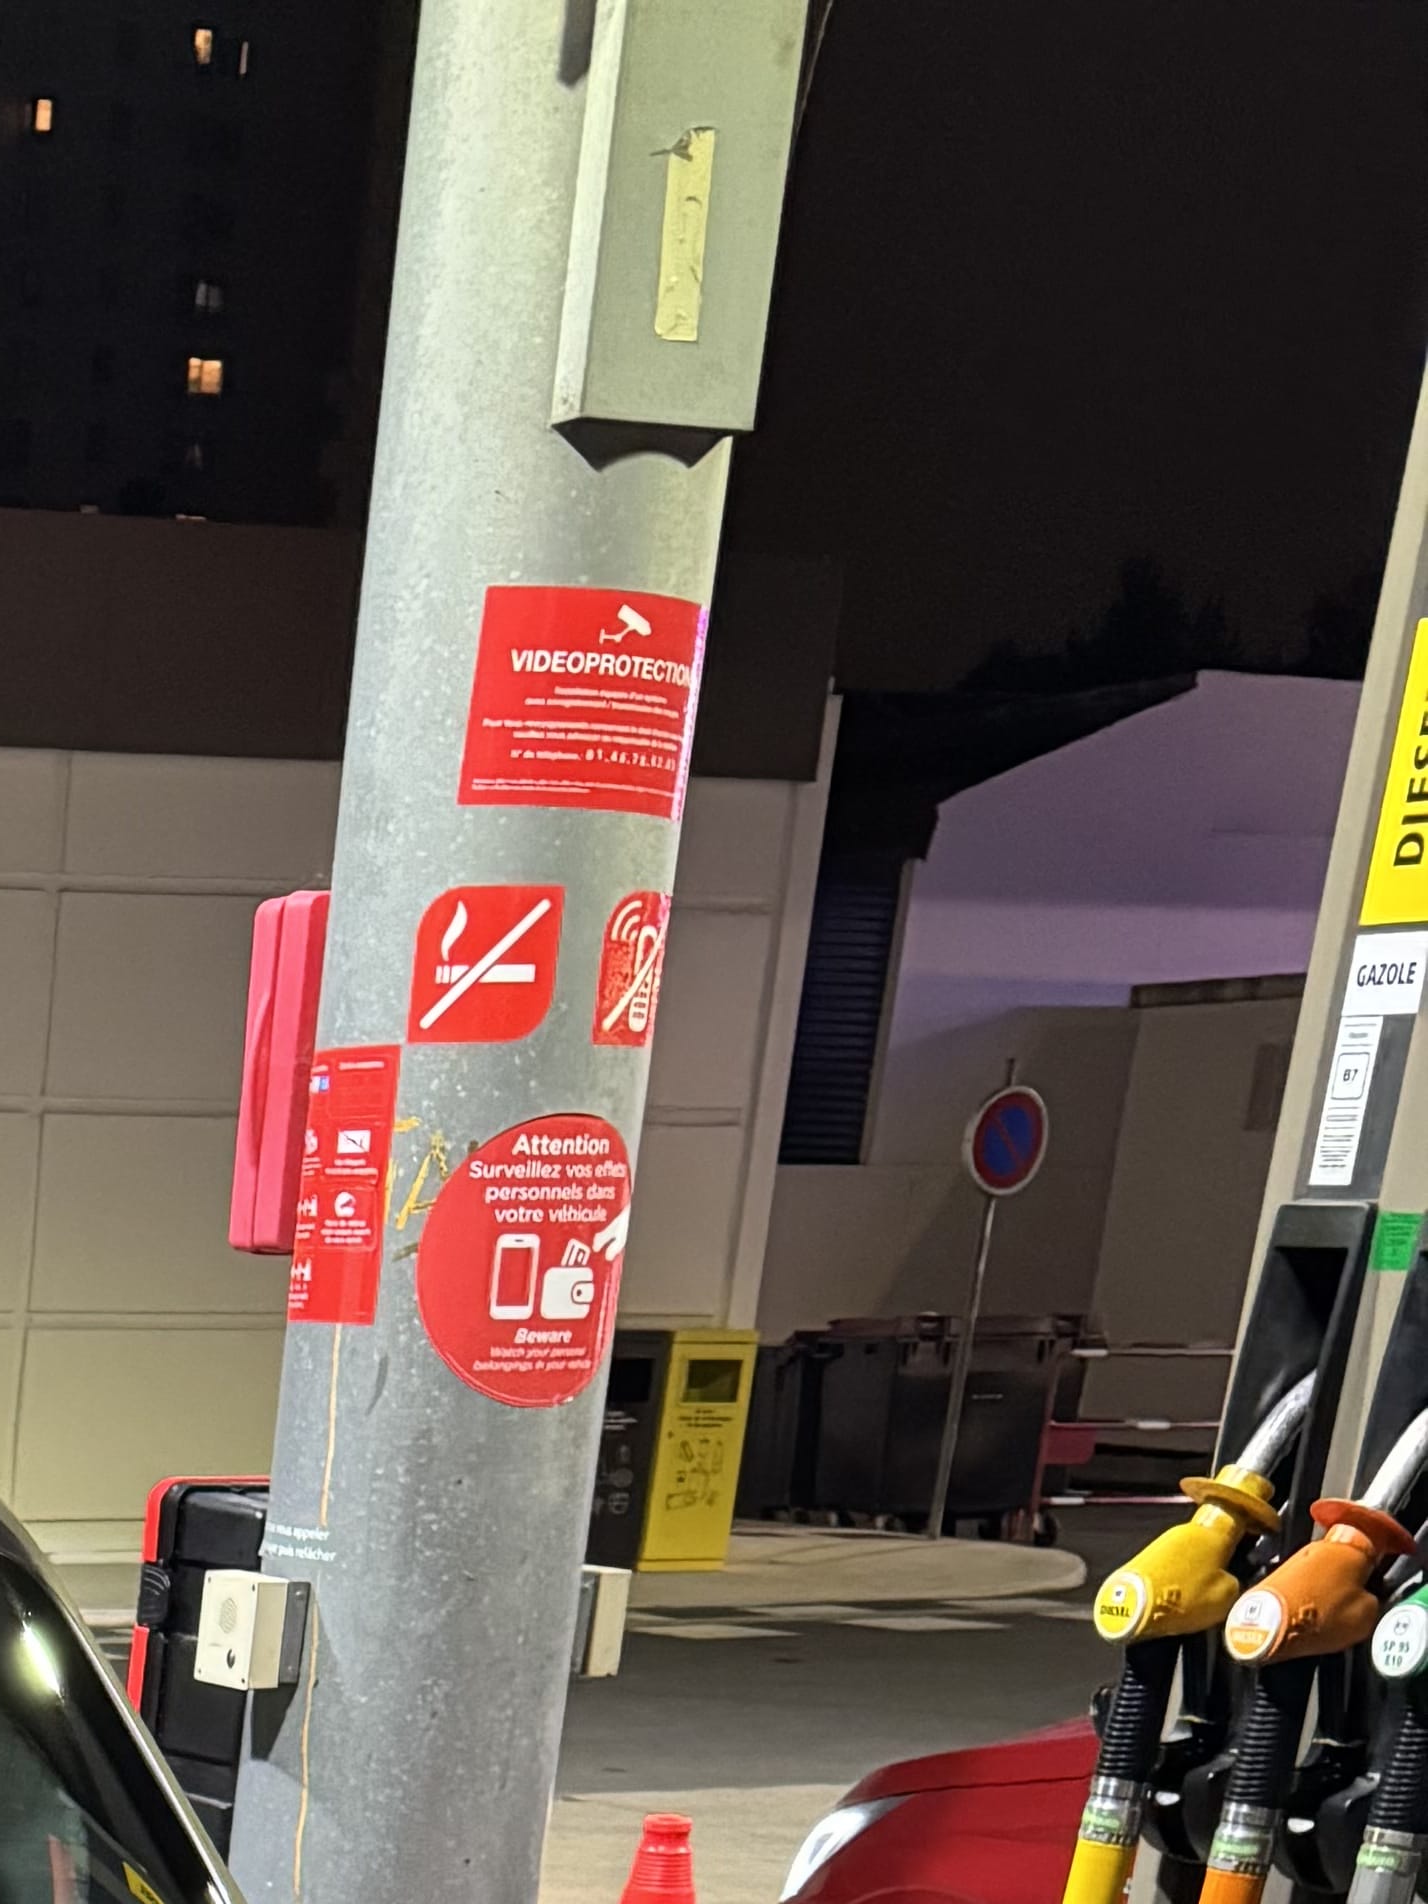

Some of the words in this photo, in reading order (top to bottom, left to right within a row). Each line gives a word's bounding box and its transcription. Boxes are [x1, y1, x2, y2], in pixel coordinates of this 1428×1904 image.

[1393, 688, 1428, 867] DIE
[1356, 962, 1417, 987] GAZOLE
[1343, 1068, 1358, 1081] B7
[511, 1133, 609, 1155] Attention
[469, 1160, 562, 1178] Surveillez
[566, 1164, 592, 1178] vos
[485, 1182, 583, 1203] personnels
[586, 1183, 615, 1200] dans
[494, 1206, 544, 1223] votre
[514, 1327, 572, 1344] Beware
